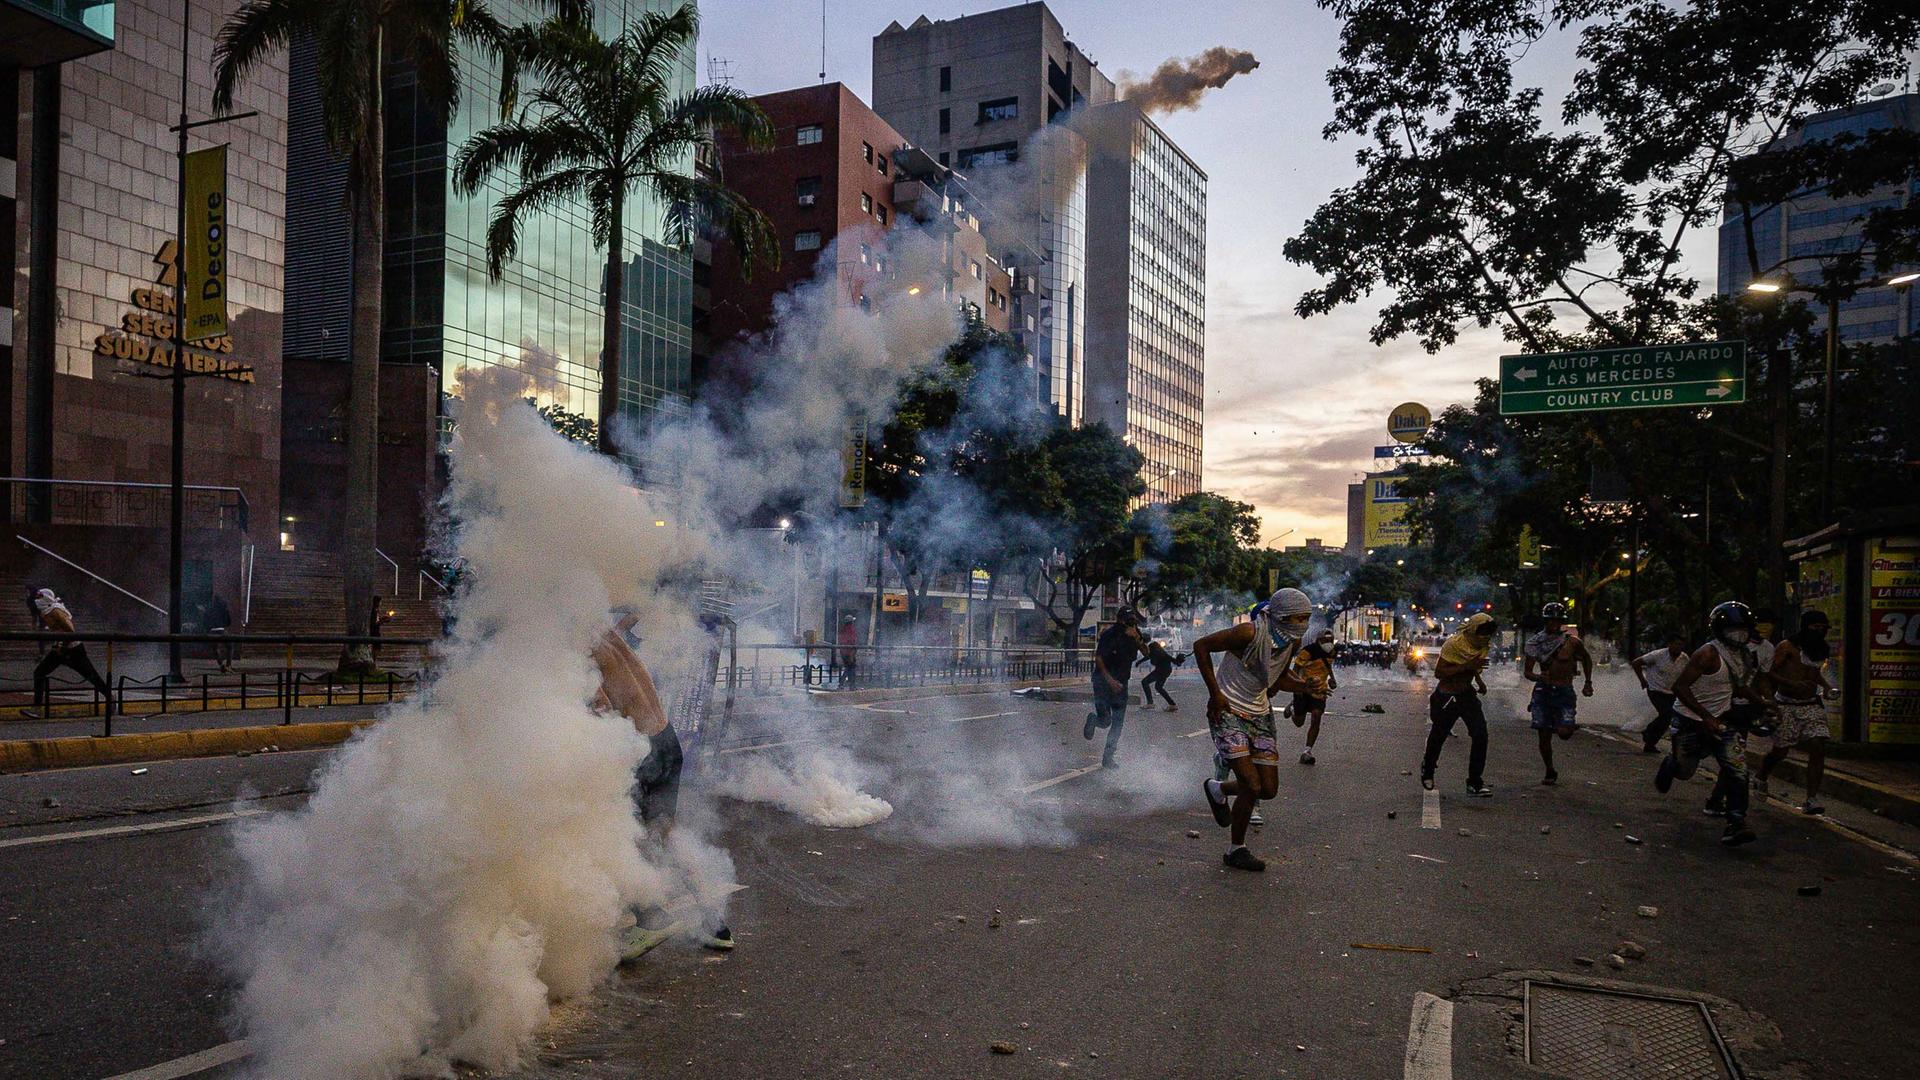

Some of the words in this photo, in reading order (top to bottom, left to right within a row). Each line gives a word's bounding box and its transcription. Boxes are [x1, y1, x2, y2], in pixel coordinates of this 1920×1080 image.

[203, 191, 221, 300] Decore
[199, 312, 221, 327] EPA
[1547, 356, 1605, 370] AUTOP.
[1611, 353, 1647, 366] FCO.
[1655, 347, 1734, 363] FAJARDO
[1547, 373, 1579, 387] LAS
[1586, 366, 1676, 384] MERCEDES
[1547, 391, 1622, 407] COUNTRY
[1630, 388, 1675, 401] CLUB
[1395, 415, 1425, 429] Daka
[1878, 588, 1892, 598] LA
